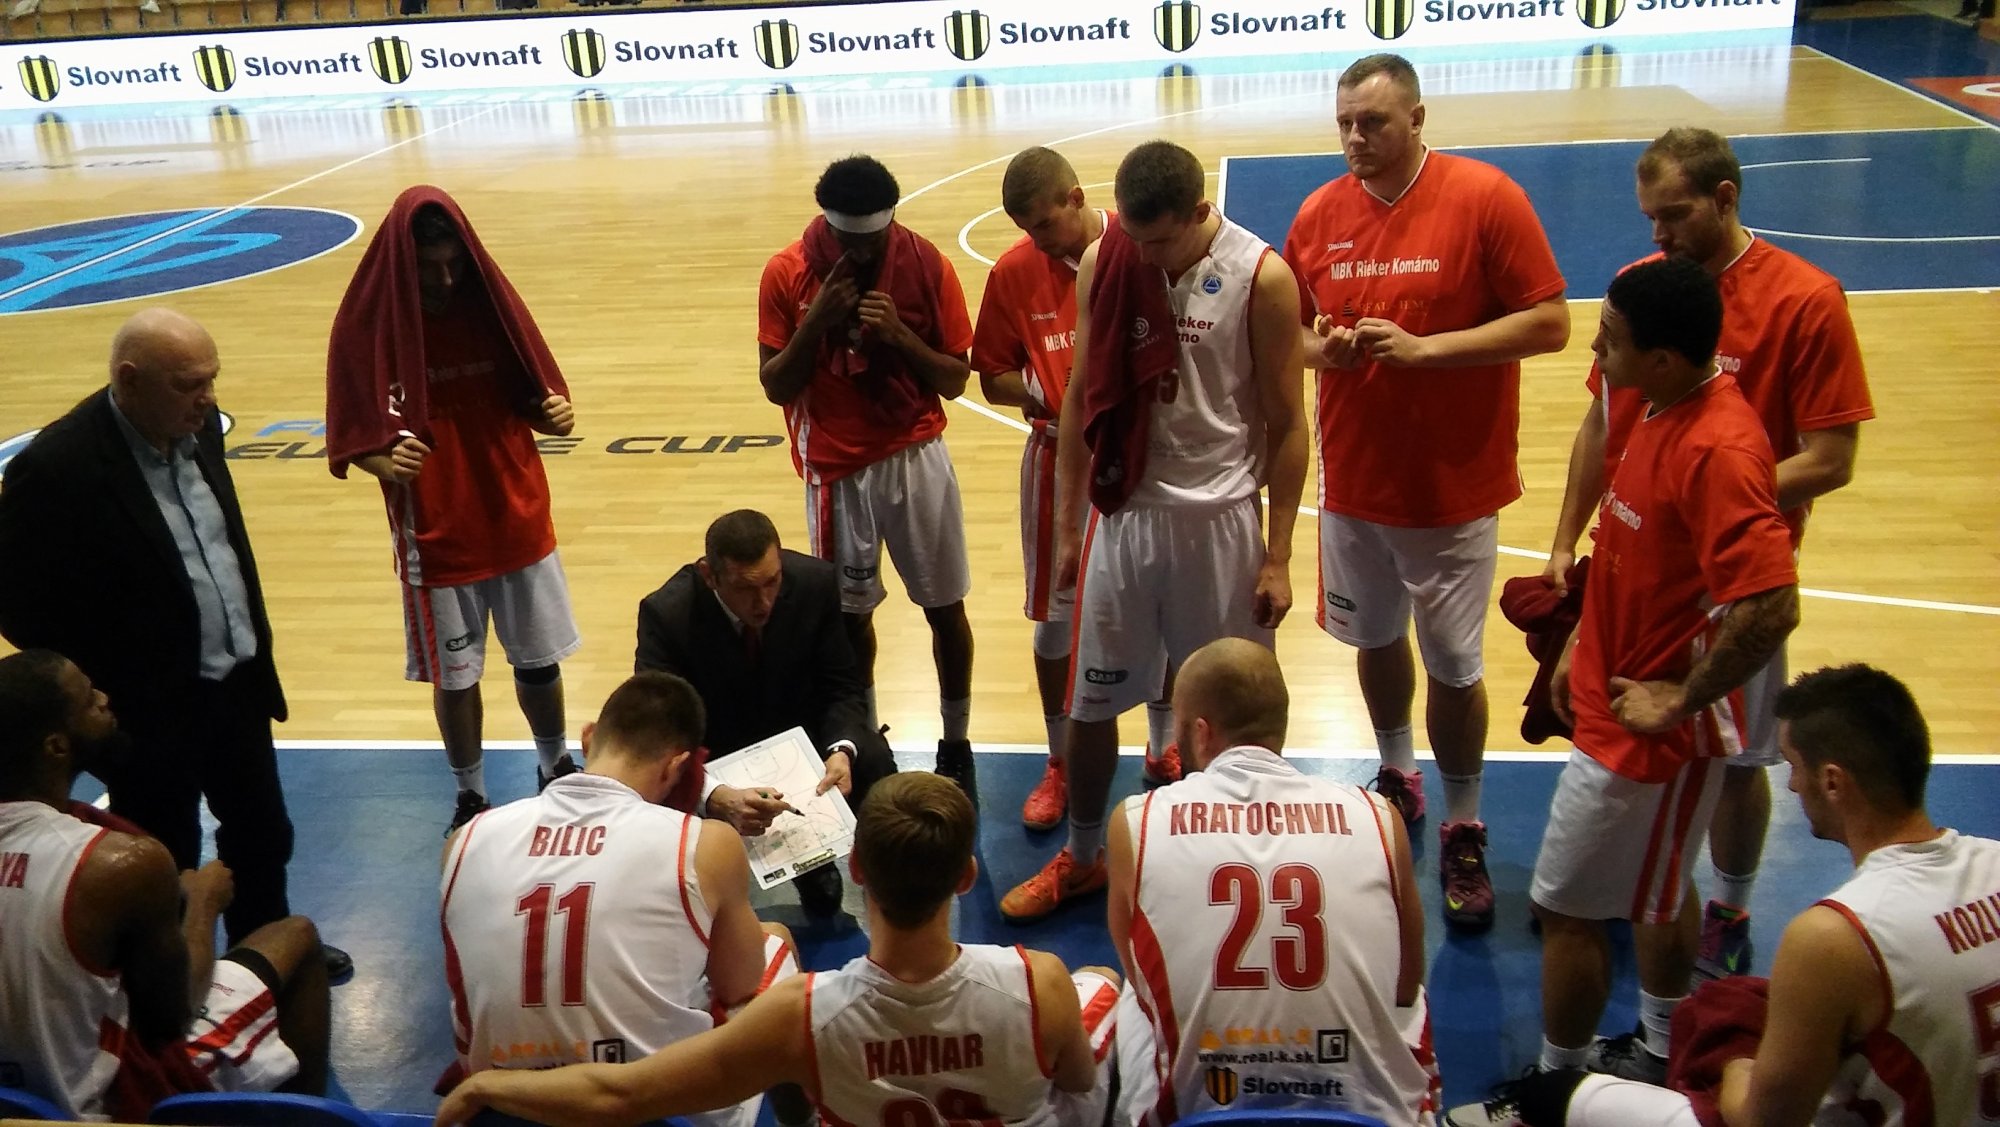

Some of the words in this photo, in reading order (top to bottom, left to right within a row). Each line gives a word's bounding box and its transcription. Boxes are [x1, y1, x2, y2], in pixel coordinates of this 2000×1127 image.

[1211, 8, 1345, 35] Slovnaft
[1425, 0, 1564, 22] Slovnaft
[809, 28, 935, 53] Slovnaft
[1000, 18, 1130, 44] Slovnaft
[421, 45, 541, 68] Slovnaft
[615, 38, 738, 62] Slovnaft
[68, 63, 181, 86] Slovnaft
[245, 53, 362, 76] Slovnaft
[1331, 262, 1354, 280] MBK
[1356, 259, 1391, 278] Rieker
[1392, 255, 1440, 275] Komárno
[1044, 332, 1069, 352] MBK
[605, 435, 785, 454] CUP
[1170, 801, 1353, 836] KRATOCHVIL
[528, 825, 606, 856] BILIC
[1209, 862, 1329, 991] 23
[514, 881, 596, 1008] 11
[864, 1033, 983, 1080] HAVIAR
[1242, 1077, 1343, 1096] Slovnaft
